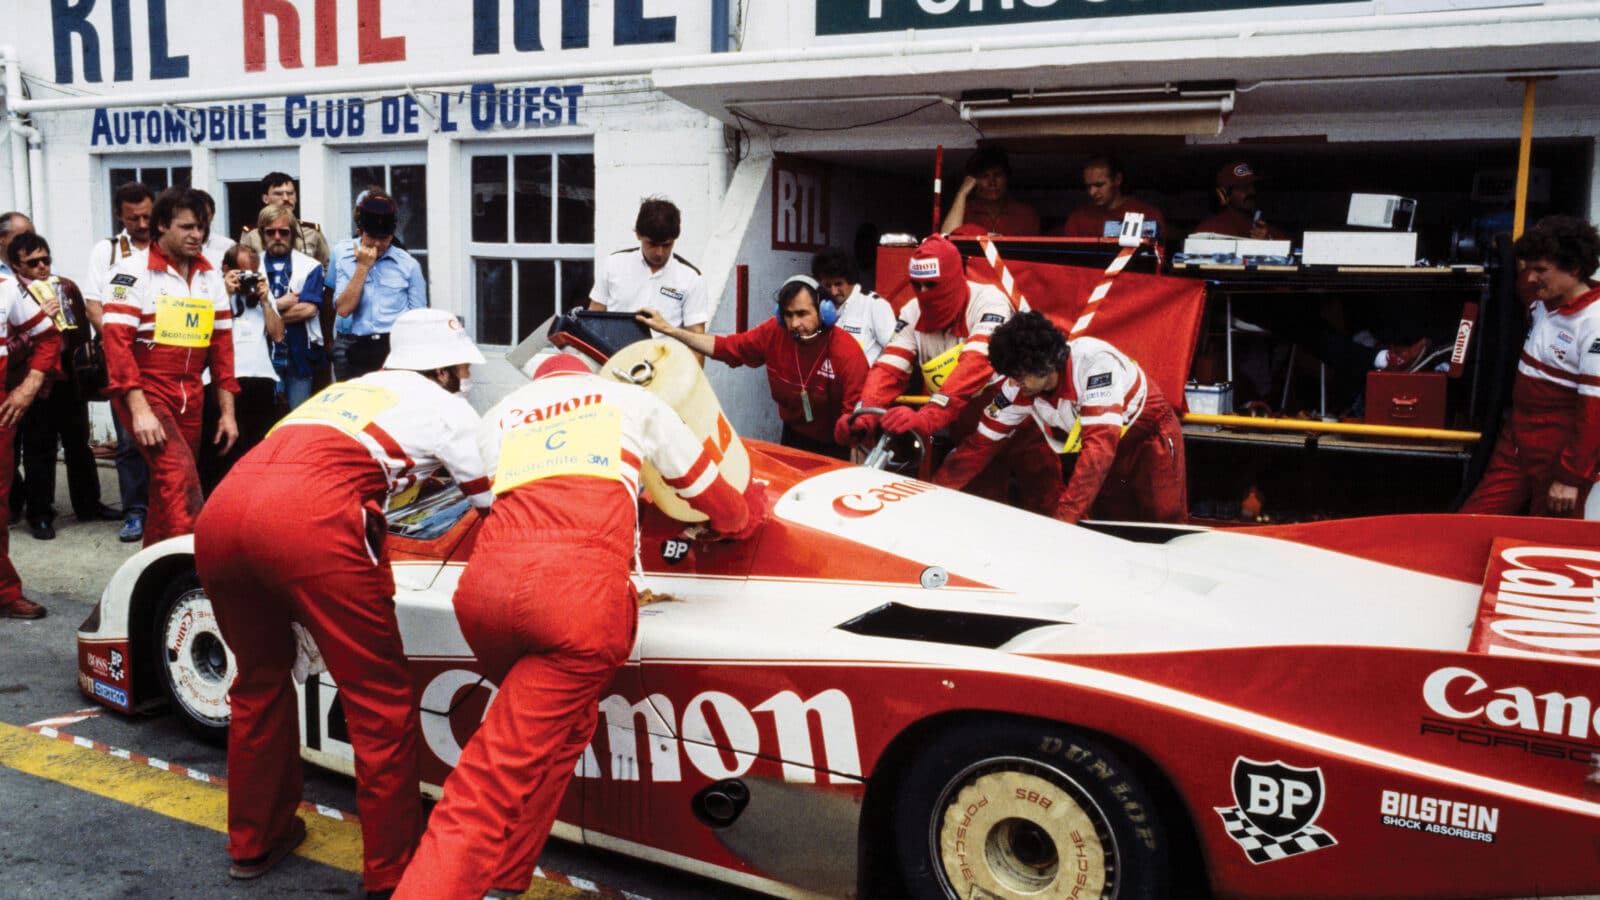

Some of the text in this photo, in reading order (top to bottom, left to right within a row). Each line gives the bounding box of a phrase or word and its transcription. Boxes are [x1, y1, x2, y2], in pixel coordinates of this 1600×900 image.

[91, 83, 584, 146] AUTOMOBILE CLUB DE L'OUEST
[776, 169, 827, 247] RTL
[186, 312, 199, 328] M
[1452, 320, 1471, 363] Canon
[500, 393, 603, 431] Canon
[545, 429, 568, 451] C
[587, 454, 610, 467] 3M
[663, 540, 688, 559] BP
[111, 649, 123, 667] BP
[95, 681, 127, 707] SEIKO
[1422, 666, 1600, 739] Can
[420, 668, 864, 784] Cnon
[1015, 787, 1053, 809] BBS
[1247, 773, 1313, 820] BP
[1380, 789, 1499, 833] BILSTEIN
[955, 795, 989, 881] PORSCHE
[1383, 815, 1493, 843] SHOCK ABSORBERS
